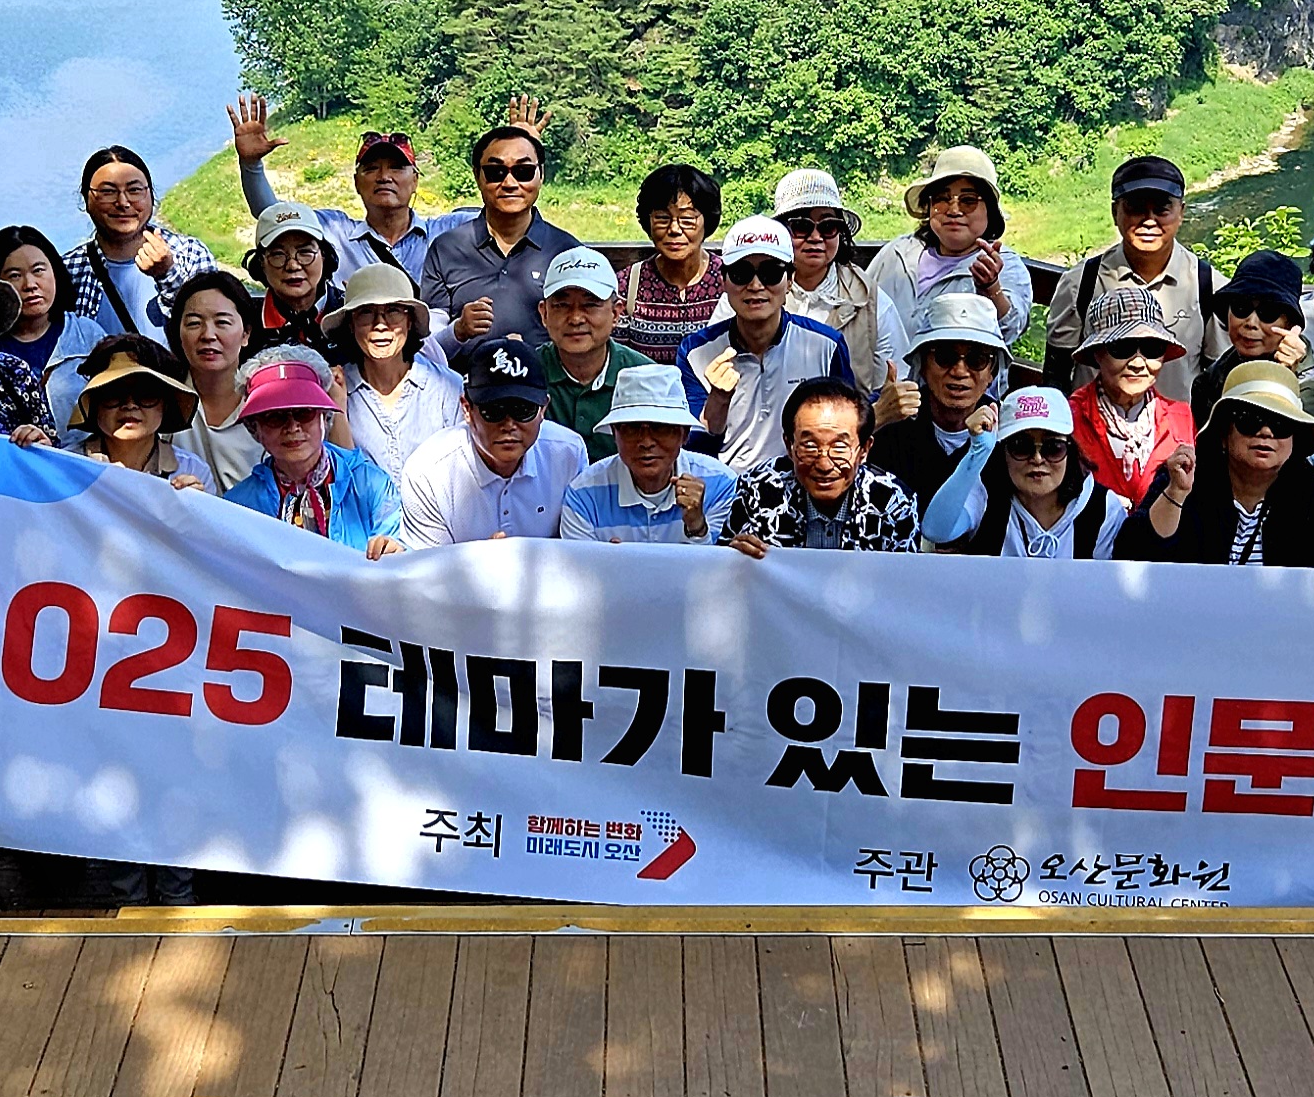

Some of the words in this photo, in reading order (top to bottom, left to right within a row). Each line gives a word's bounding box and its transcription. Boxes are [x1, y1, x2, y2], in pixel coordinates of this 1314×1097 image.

[335, 624, 727, 779] 테마가
[763, 675, 1021, 805] 있는
[419, 808, 503, 859] 주최
[526, 814, 601, 838] 함께하는
[605, 821, 643, 842] 변화
[525, 836, 600, 860] 미래도시
[603, 842, 642, 863] 오산
[852, 847, 939, 893] 주관
[1039, 853, 1231, 891] 오산문화원
[1038, 890, 1082, 905] OSAN
[1086, 892, 1163, 908] CULTURAL
